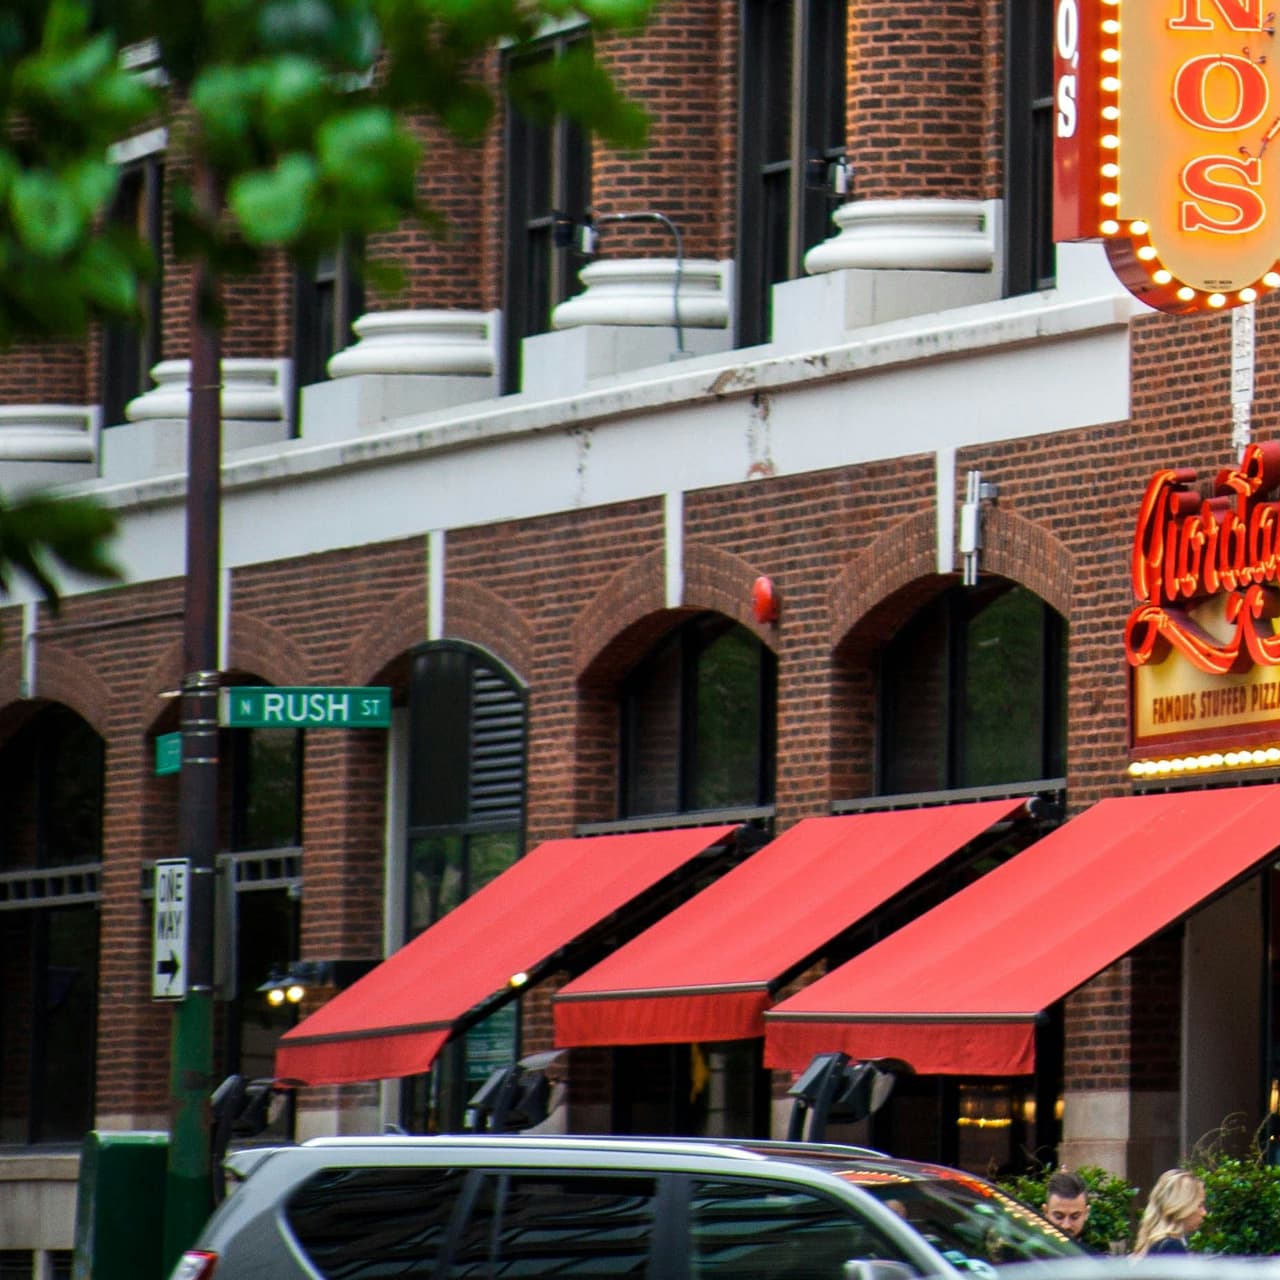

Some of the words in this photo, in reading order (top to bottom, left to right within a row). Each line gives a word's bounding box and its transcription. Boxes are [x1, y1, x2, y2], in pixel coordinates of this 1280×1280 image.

[240, 699, 252, 715] N
[263, 693, 350, 722] RUSH
[360, 699, 380, 717] ST
[1152, 693, 1196, 725] FAMOUS
[1200, 687, 1247, 719] STUFFED
[158, 871, 184, 903] ONE
[157, 910, 182, 940] WAY
